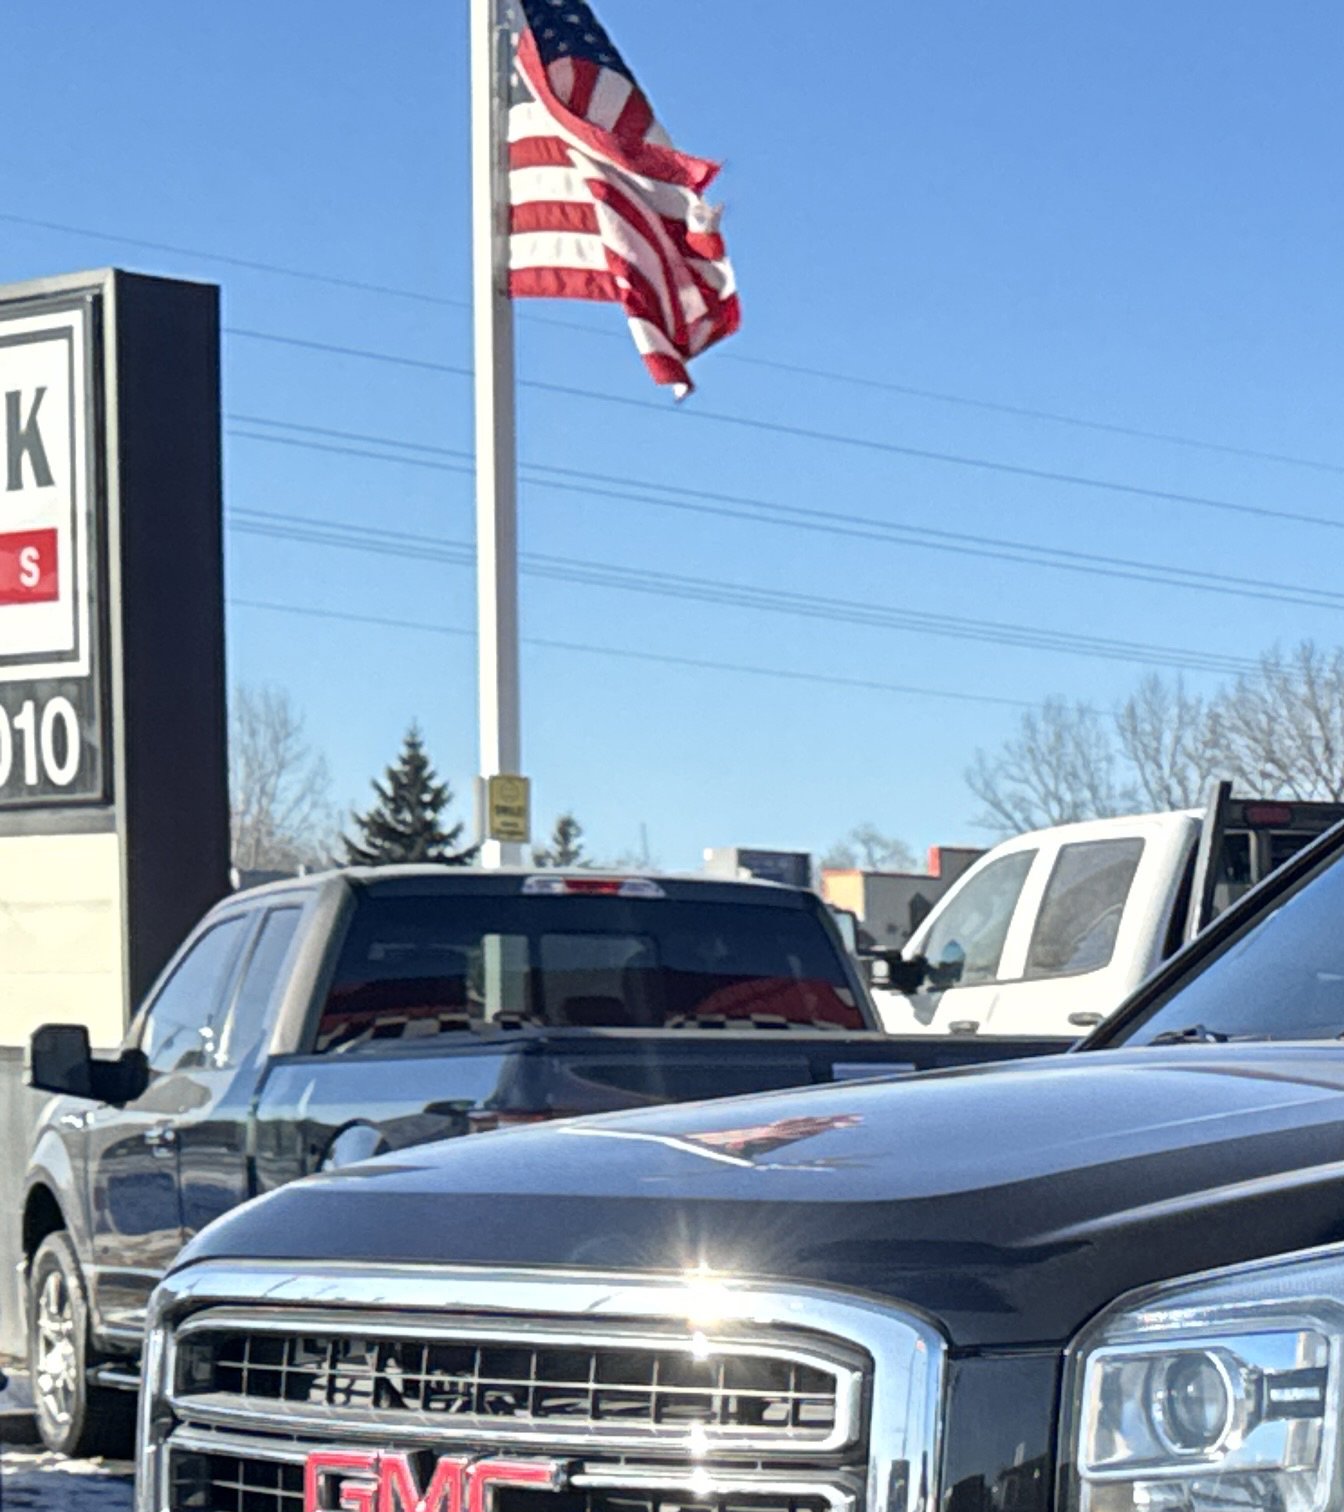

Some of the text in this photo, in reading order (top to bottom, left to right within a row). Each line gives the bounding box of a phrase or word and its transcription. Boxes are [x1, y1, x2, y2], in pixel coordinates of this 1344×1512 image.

[5, 385, 56, 492] K
[19, 545, 41, 588] S
[0, 695, 80, 787] 10
